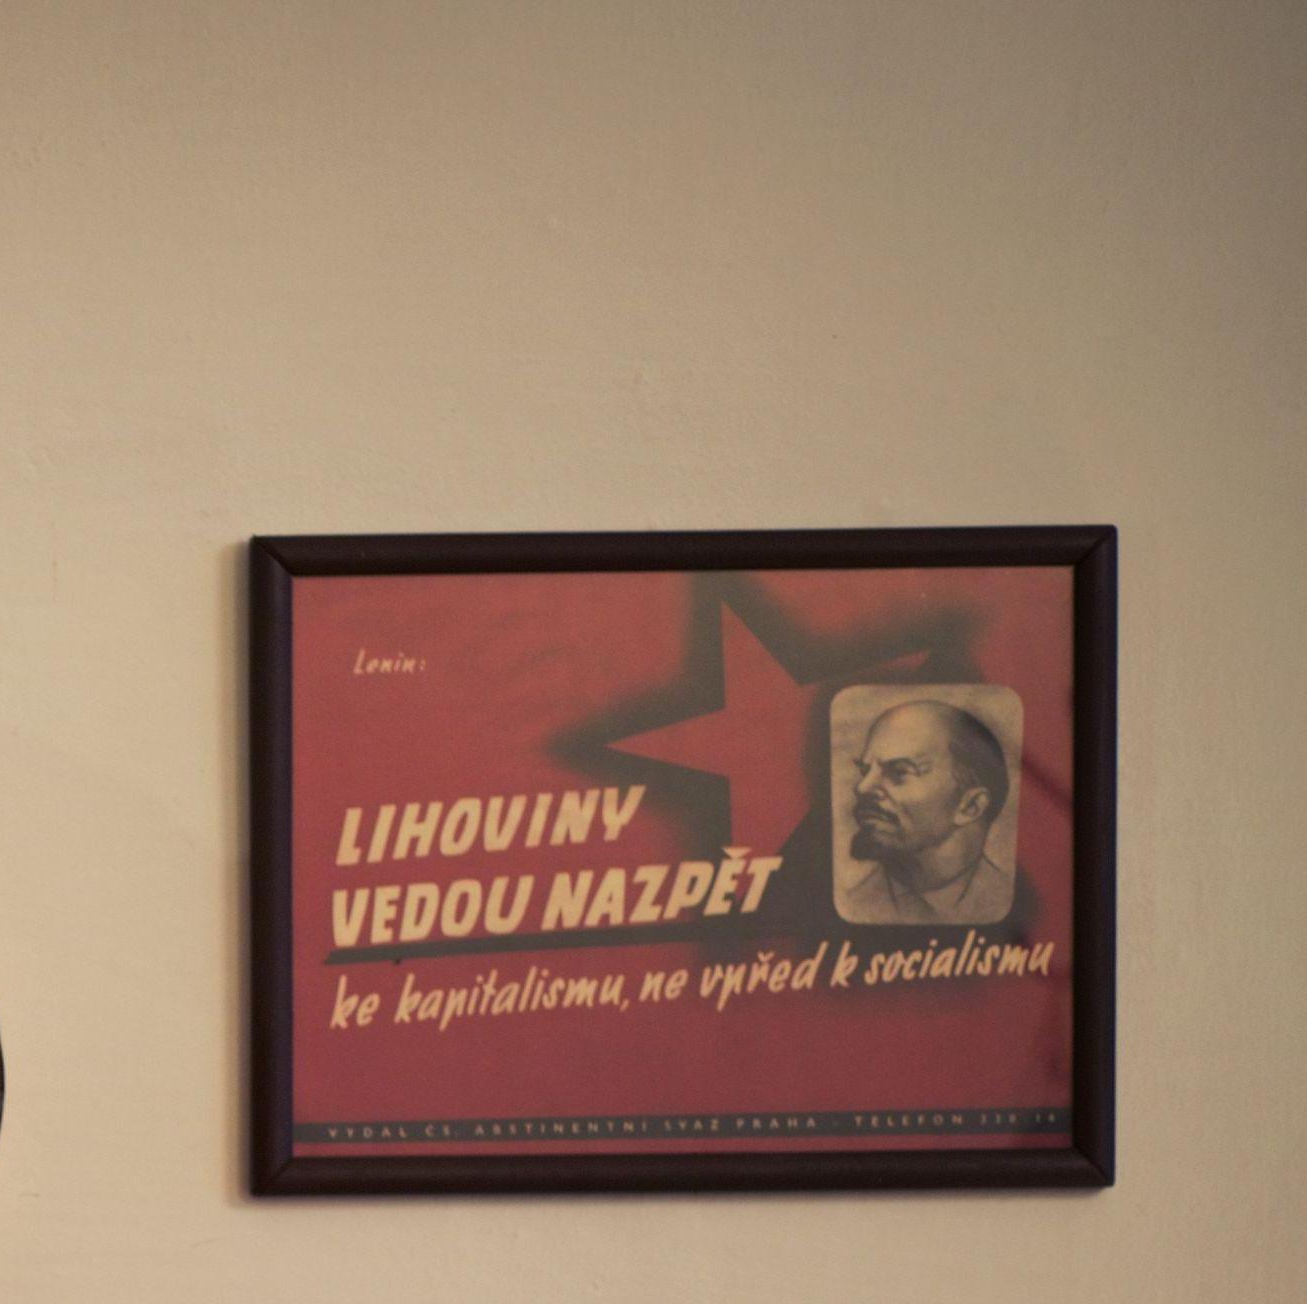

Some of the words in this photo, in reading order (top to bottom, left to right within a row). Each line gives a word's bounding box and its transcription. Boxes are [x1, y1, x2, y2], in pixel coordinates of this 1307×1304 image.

[334, 785, 647, 867] LIHOVINY
[331, 874, 536, 948] VEDOU
[539, 846, 784, 932] NAZPĚT
[329, 973, 381, 1030] ke
[393, 965, 631, 1032] kapitalismu,
[637, 967, 690, 1003] ne
[698, 939, 830, 1013] vpřed
[829, 939, 860, 989] k
[862, 928, 1056, 986] socialismu
[736, 1114, 817, 1131] PRAHA
[853, 1112, 965, 1128] TELEFON
